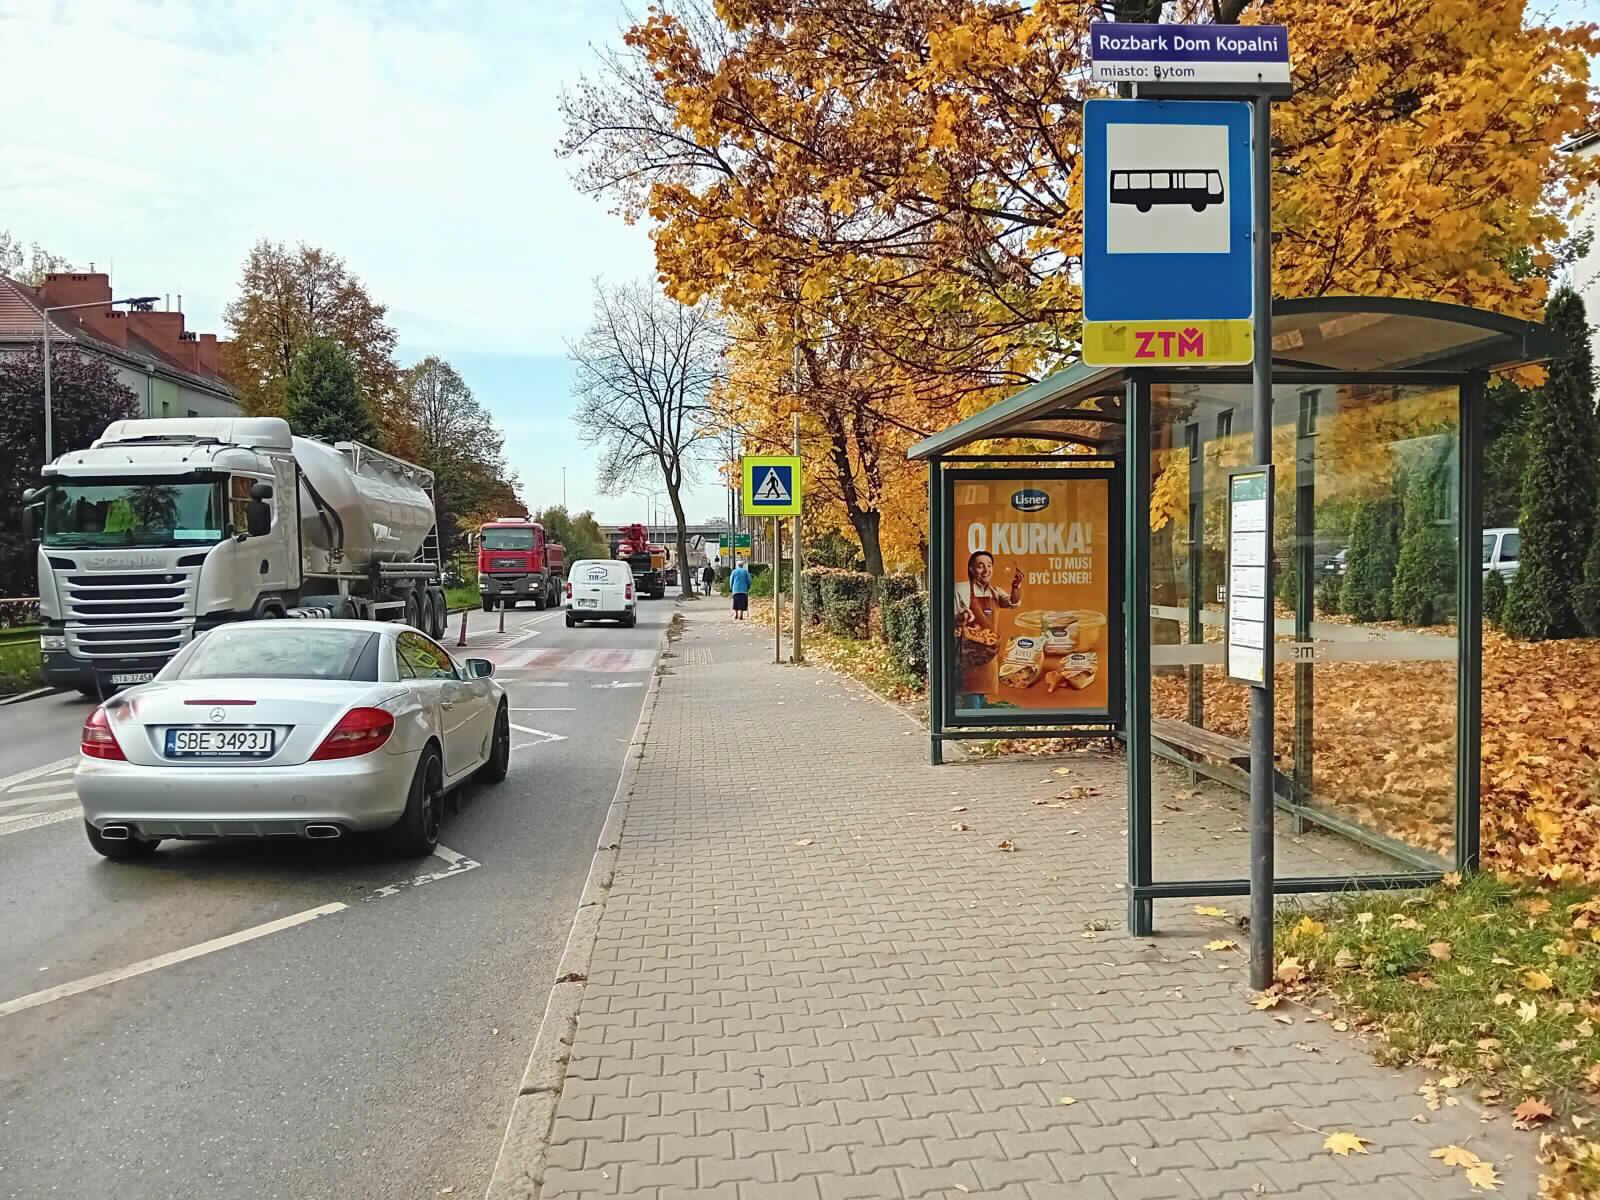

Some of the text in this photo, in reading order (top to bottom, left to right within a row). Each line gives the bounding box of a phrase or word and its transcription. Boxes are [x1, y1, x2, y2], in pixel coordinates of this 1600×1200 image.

[1100, 35, 1278, 54] Rozbark Dom Kopalni
[1100, 66, 1195, 79] miasto: Bytom
[1135, 328, 1204, 358] ZTM
[1015, 494, 1047, 505] Lisner
[967, 521, 1093, 555] O KURKA!
[1048, 557, 1093, 569] TO MUSI
[1052, 572, 1093, 584] LISNER!
[177, 732, 268, 750] SBE 3493J
